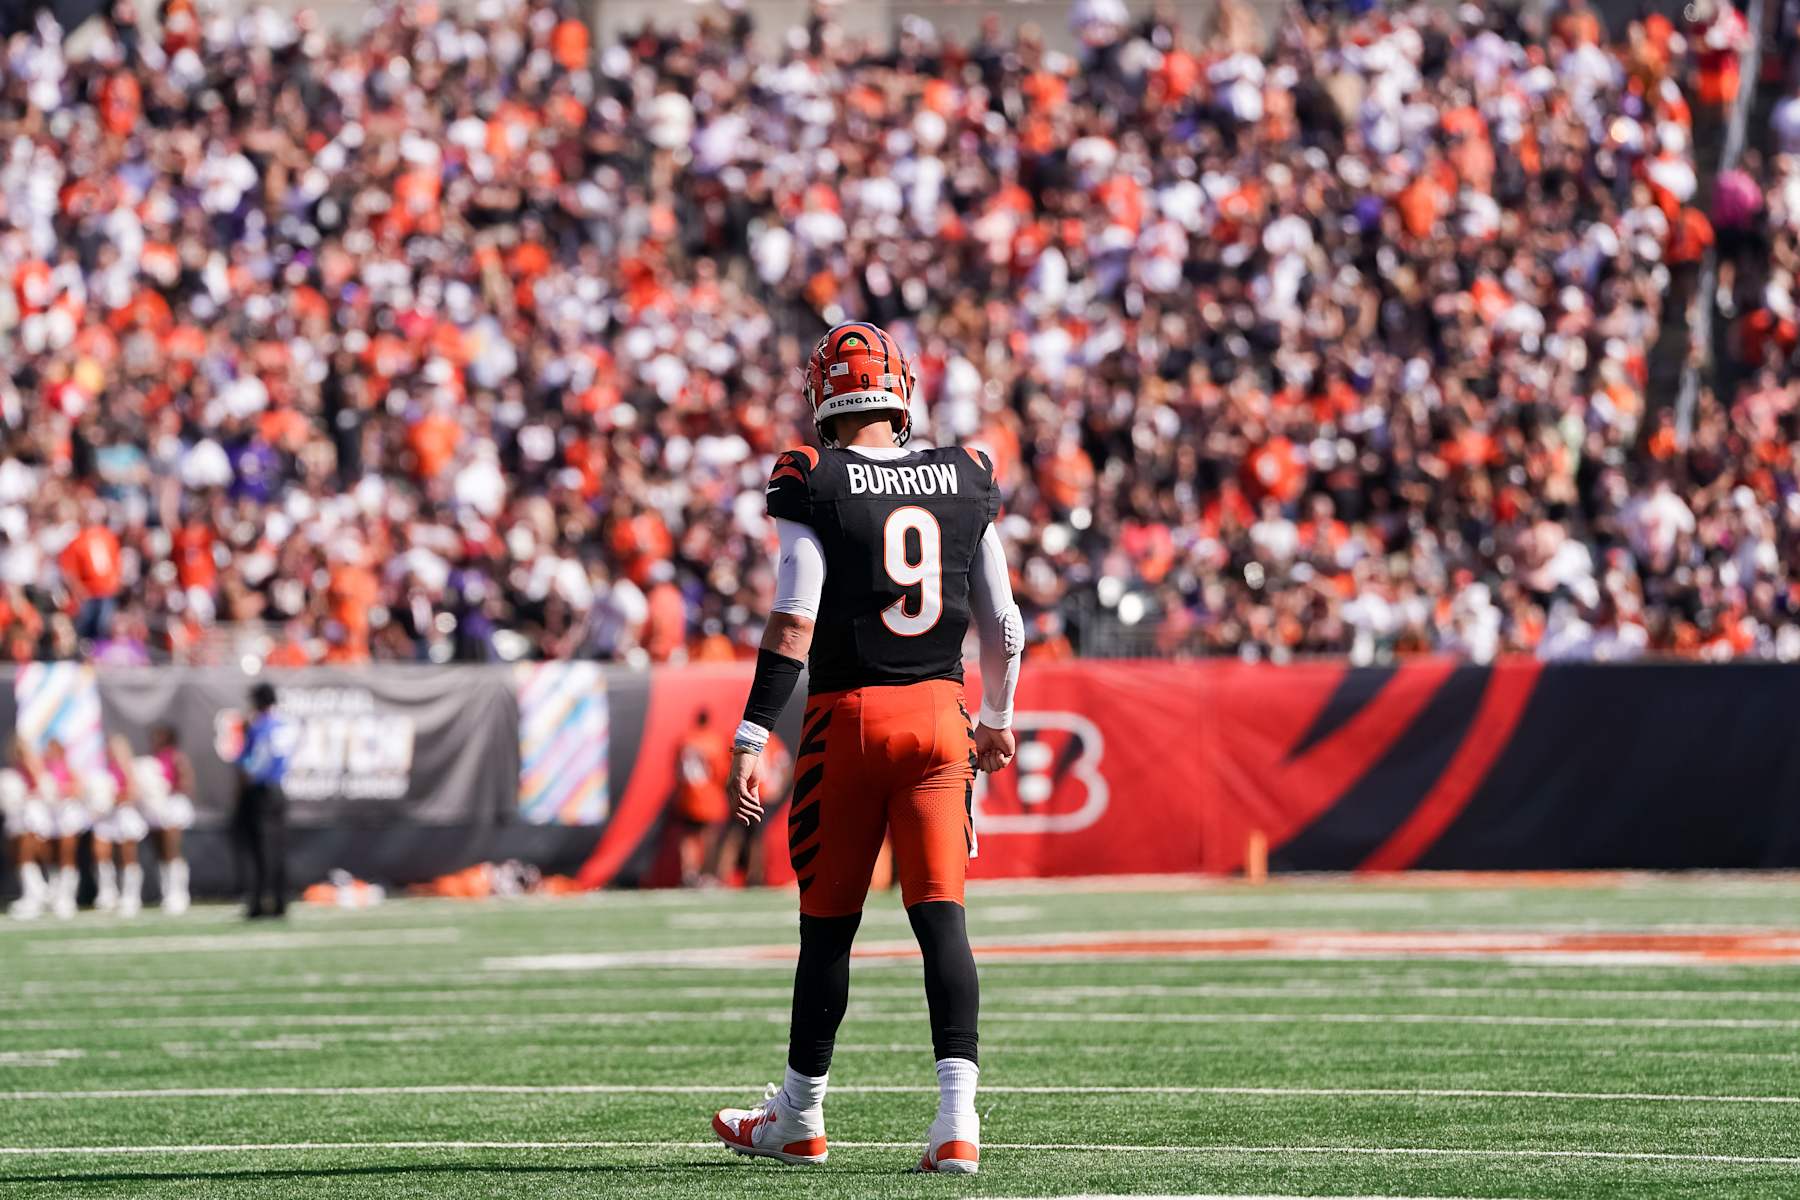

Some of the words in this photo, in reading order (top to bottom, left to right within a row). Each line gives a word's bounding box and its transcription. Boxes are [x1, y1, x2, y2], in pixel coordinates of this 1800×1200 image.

[860, 373, 870, 390] 9
[829, 395, 888, 409] BENGALS
[846, 463, 958, 495] BURROW
[880, 505, 943, 637] 9
